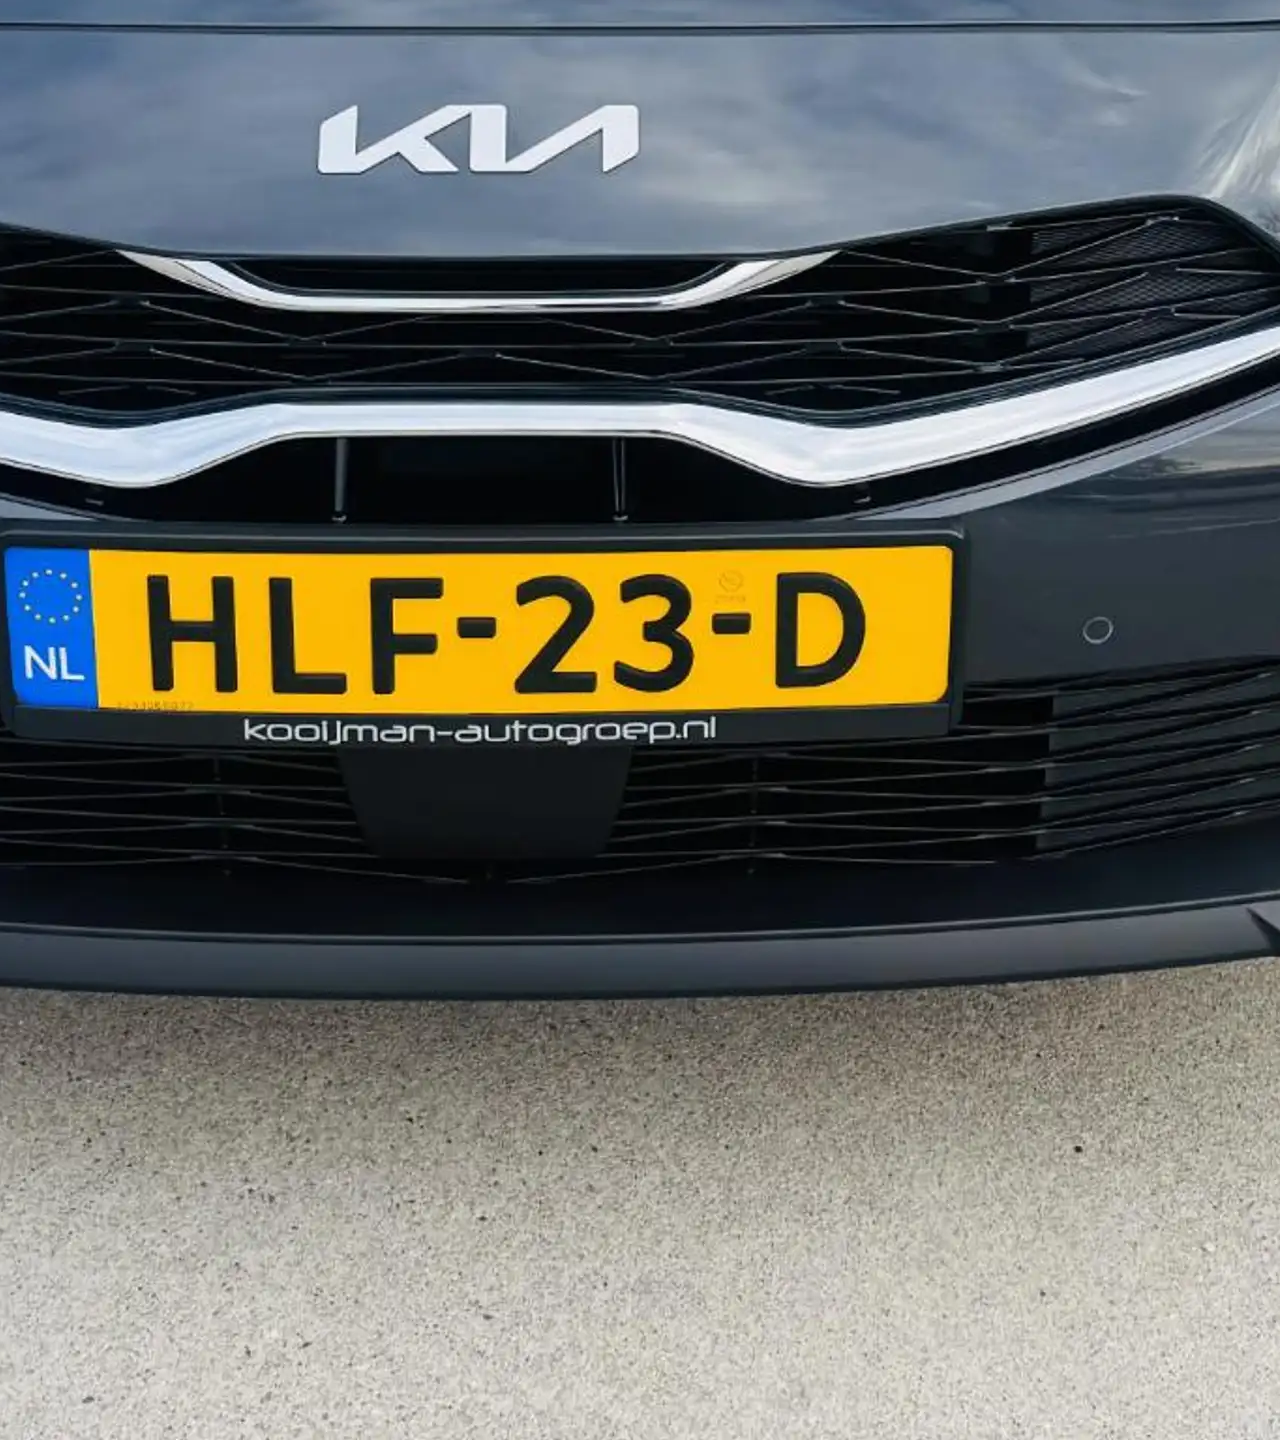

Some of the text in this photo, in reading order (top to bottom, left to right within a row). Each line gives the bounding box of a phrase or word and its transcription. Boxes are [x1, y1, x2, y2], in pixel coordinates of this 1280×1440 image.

[318, 104, 639, 173] KIA
[146, 571, 866, 696] HLF-23-D
[24, 645, 86, 681] NL
[243, 716, 717, 746] kooijman-autogroep.nl
